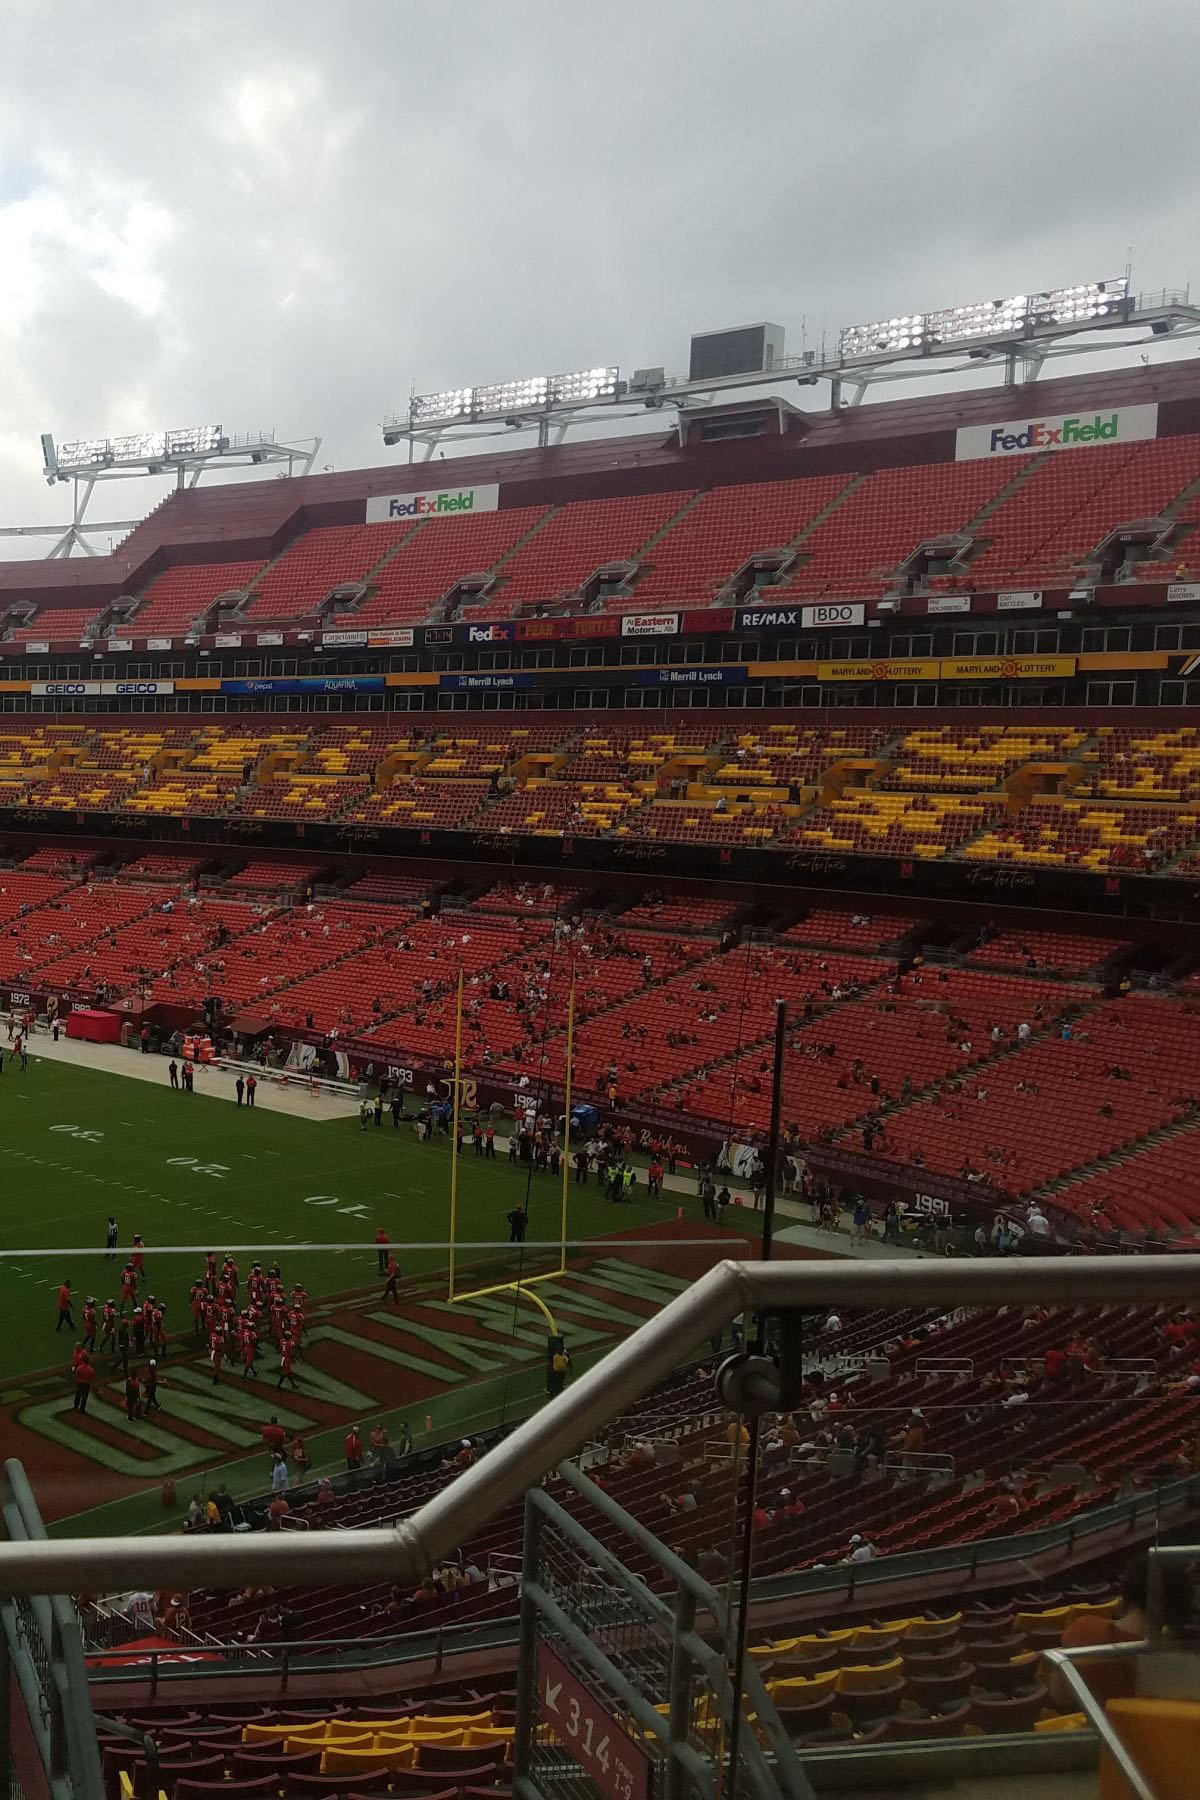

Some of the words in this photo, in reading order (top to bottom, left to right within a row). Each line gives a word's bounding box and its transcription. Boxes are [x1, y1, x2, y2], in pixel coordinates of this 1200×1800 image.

[990, 414, 1119, 452] FedExField
[389, 491, 474, 517] FedExField
[742, 612, 799, 626] RE/MAX
[818, 606, 853, 621] BDO
[634, 617, 674, 626] Eastern
[469, 626, 508, 642] FedEx
[832, 667, 871, 676] MARYLAND
[889, 667, 922, 675] LOTTERY
[956, 665, 1000, 673] MARYLAND
[1019, 664, 1056, 672] LOTTERY
[468, 676, 492, 686] Merrill
[492, 676, 514, 687] Lynch
[670, 671, 697, 682] Merrill
[698, 670, 723, 682] Lynch
[46, 684, 85, 694] GEICO
[116, 684, 157, 693] GEICO
[254, 682, 273, 692] pepsi
[323, 680, 358, 691] AQUAFINA
[10, 992, 30, 1005] 1972
[914, 1193, 950, 1215] 1991
[566, 1698, 610, 1774] 314
[615, 1756, 634, 1785] rows
[614, 1773, 631, 1800] 1-9
